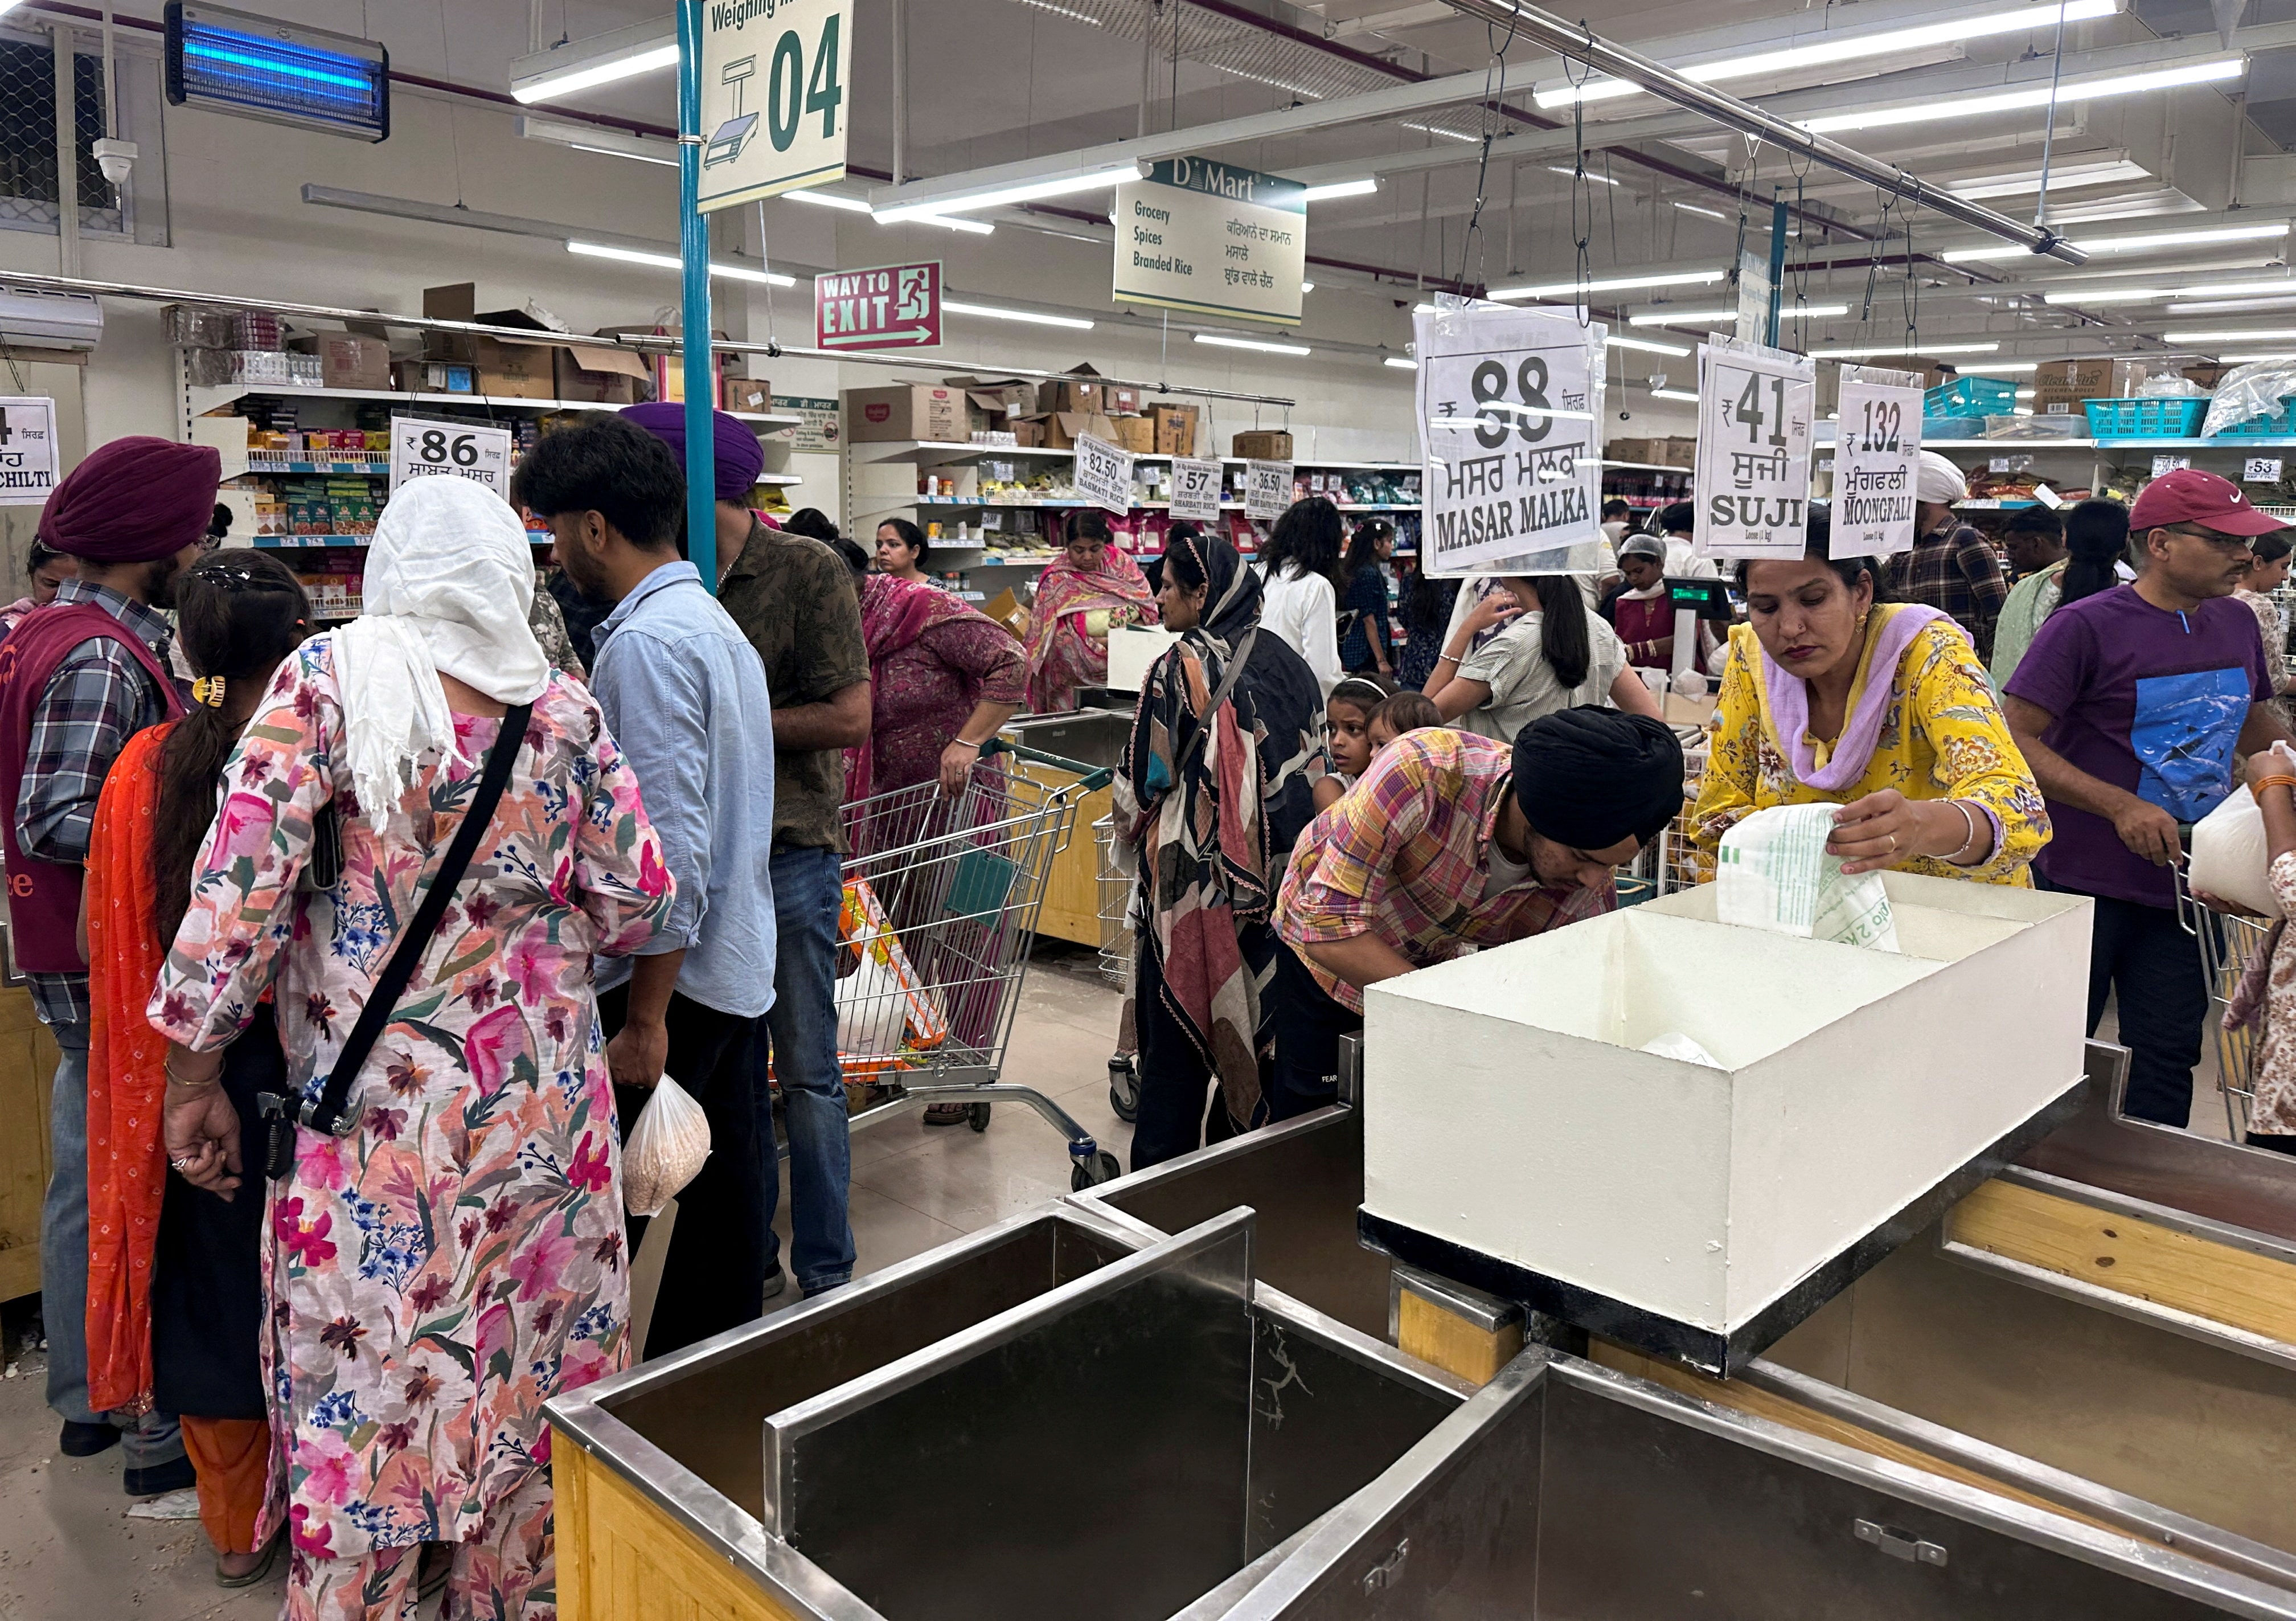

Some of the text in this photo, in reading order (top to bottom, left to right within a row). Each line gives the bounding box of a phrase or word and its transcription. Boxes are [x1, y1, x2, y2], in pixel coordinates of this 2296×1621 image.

[711, 0, 775, 32] Weighing
[769, 13, 841, 153] 04
[1135, 200, 1170, 225] Grocery
[1134, 226, 1162, 245] Spices
[1259, 228, 1269, 240] ਦਾ
[1270, 230, 1292, 245] ਸਮਾਨ
[1133, 251, 1192, 275] Branded Rice
[1225, 244, 1249, 261] ਮਸਾਲੇ
[823, 272, 888, 298] WAY TO
[1241, 269, 1258, 286] ਵਾਲੇ
[824, 295, 889, 334] EXIT
[1471, 357, 1553, 449] 88
[1736, 371, 1787, 447] 41
[1862, 400, 1901, 453] 132
[421, 430, 478, 466] 86
[1089, 453, 1117, 480] 82.50
[1445, 441, 1585, 500] ਮਸਰ ਮਲਕਾ
[1731, 447, 1790, 489] ਸੂਜੀ
[1079, 478, 1108, 498] BASMATI
[1110, 492, 1125, 505] RICE
[1186, 472, 1209, 491] 57
[1259, 472, 1280, 491] 36.50
[1174, 500, 1202, 509] SHARBATI
[1710, 494, 1803, 527] SUJI
[1843, 496, 1912, 526] MOONGFALI
[1436, 486, 1589, 553] MASAR MALKA
[1745, 529, 1758, 541] Loose
[1863, 531, 1873, 541] Loose
